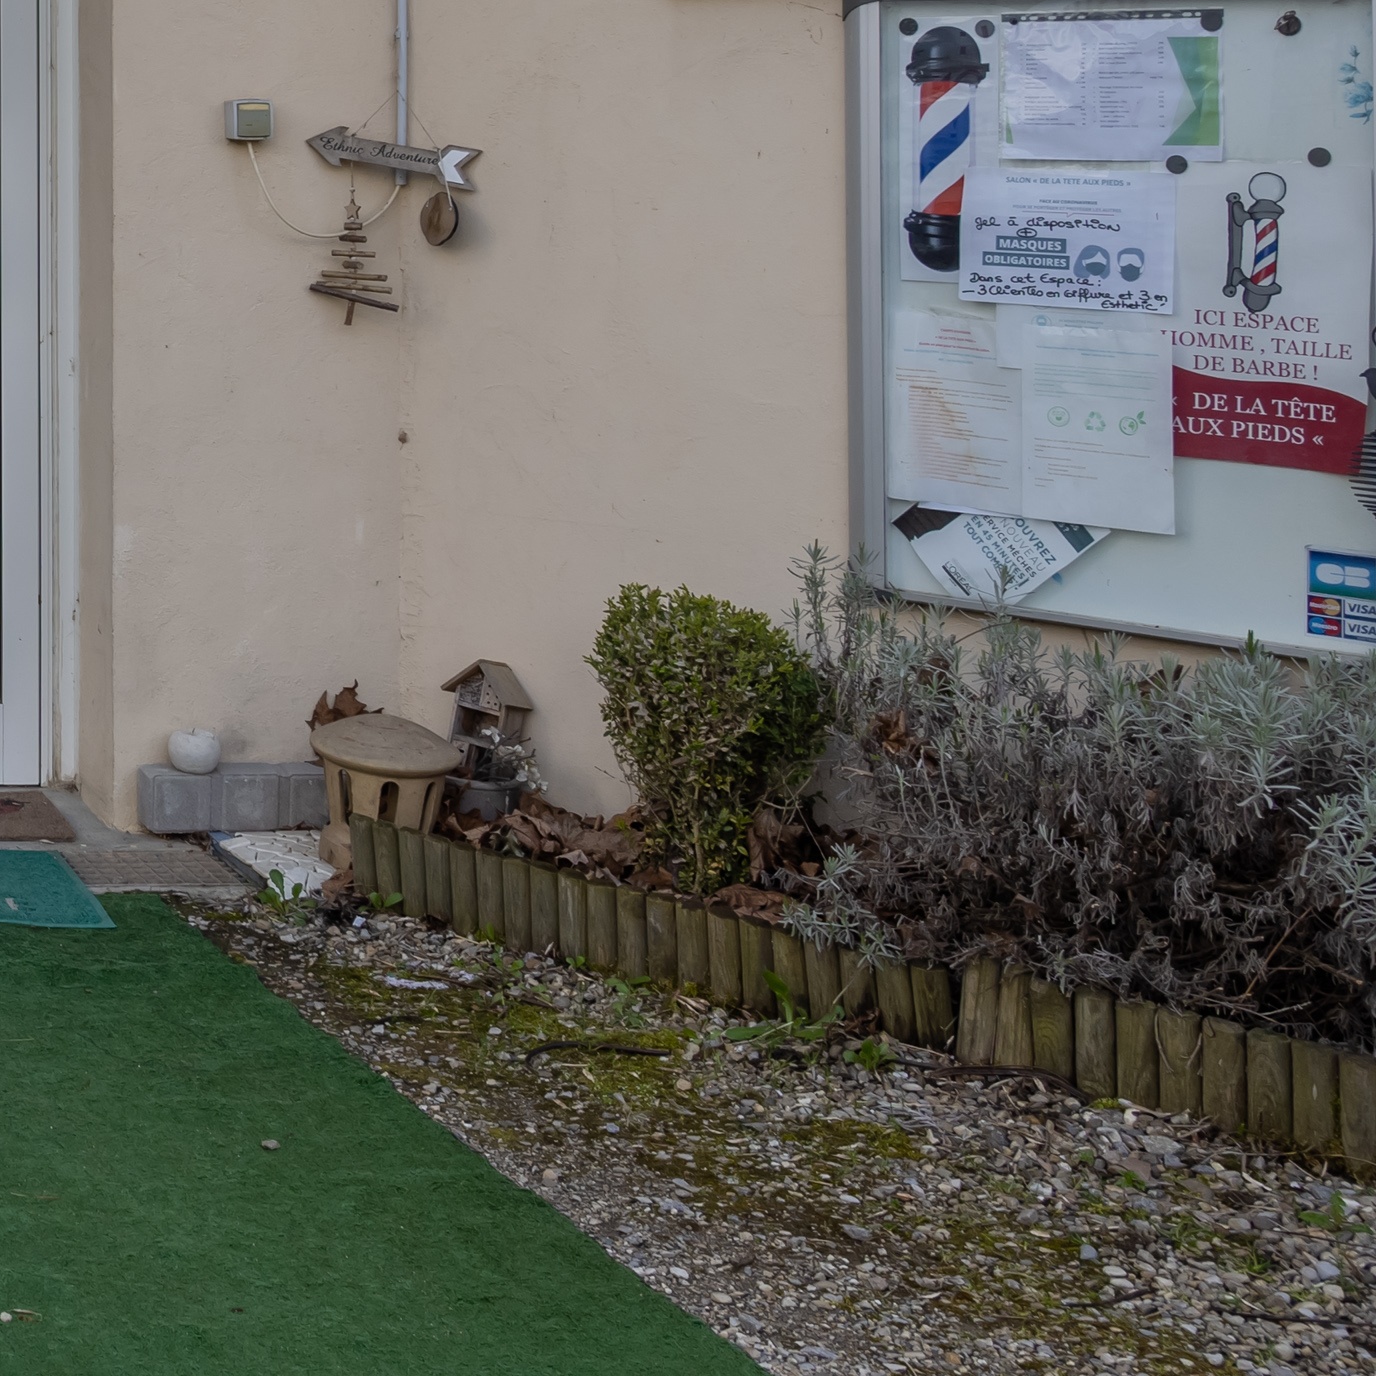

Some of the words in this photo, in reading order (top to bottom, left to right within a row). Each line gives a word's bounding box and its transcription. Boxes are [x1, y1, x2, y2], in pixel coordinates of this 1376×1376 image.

[319, 135, 365, 156] Ethnic
[1005, 176, 1032, 184] SALON
[1039, 177, 1050, 185] DE
[1051, 177, 1061, 185] LA
[1082, 178, 1099, 186] AUX
[1100, 179, 1125, 187] PIEDS
[1026, 216, 1121, 233] disposition
[999, 237, 1062, 252] MASQUES
[984, 254, 1067, 268] OBLIGATOIRES
[969, 272, 1003, 284] Dans
[1010, 273, 1036, 284] cet
[1039, 273, 1094, 287] Espace
[1047, 291, 1061, 299] en
[1118, 291, 1134, 301] et
[1153, 294, 1169, 303] en
[1194, 309, 1226, 327] ICI
[1232, 311, 1320, 334] ESPACE
[1270, 337, 1353, 361] TAILLE
[1193, 354, 1225, 372] DE
[1231, 357, 1307, 380] BARBE
[1192, 392, 1228, 412] DE
[1234, 395, 1268, 416] LA
[1271, 396, 1337, 423] TÊTE
[1172, 416, 1225, 437] AUX
[1230, 420, 1306, 446] PIEDS
[963, 521, 983, 545] TOUT
[981, 514, 1010, 545] ERVICE
[1010, 516, 1058, 566] OUVREZ
[981, 529, 993, 542] 45
[991, 541, 1027, 580] MINUTES
[1000, 517, 1046, 573] NOUVEAU
[1347, 602, 1376, 615] VISA
[1347, 622, 1376, 636] VISA
